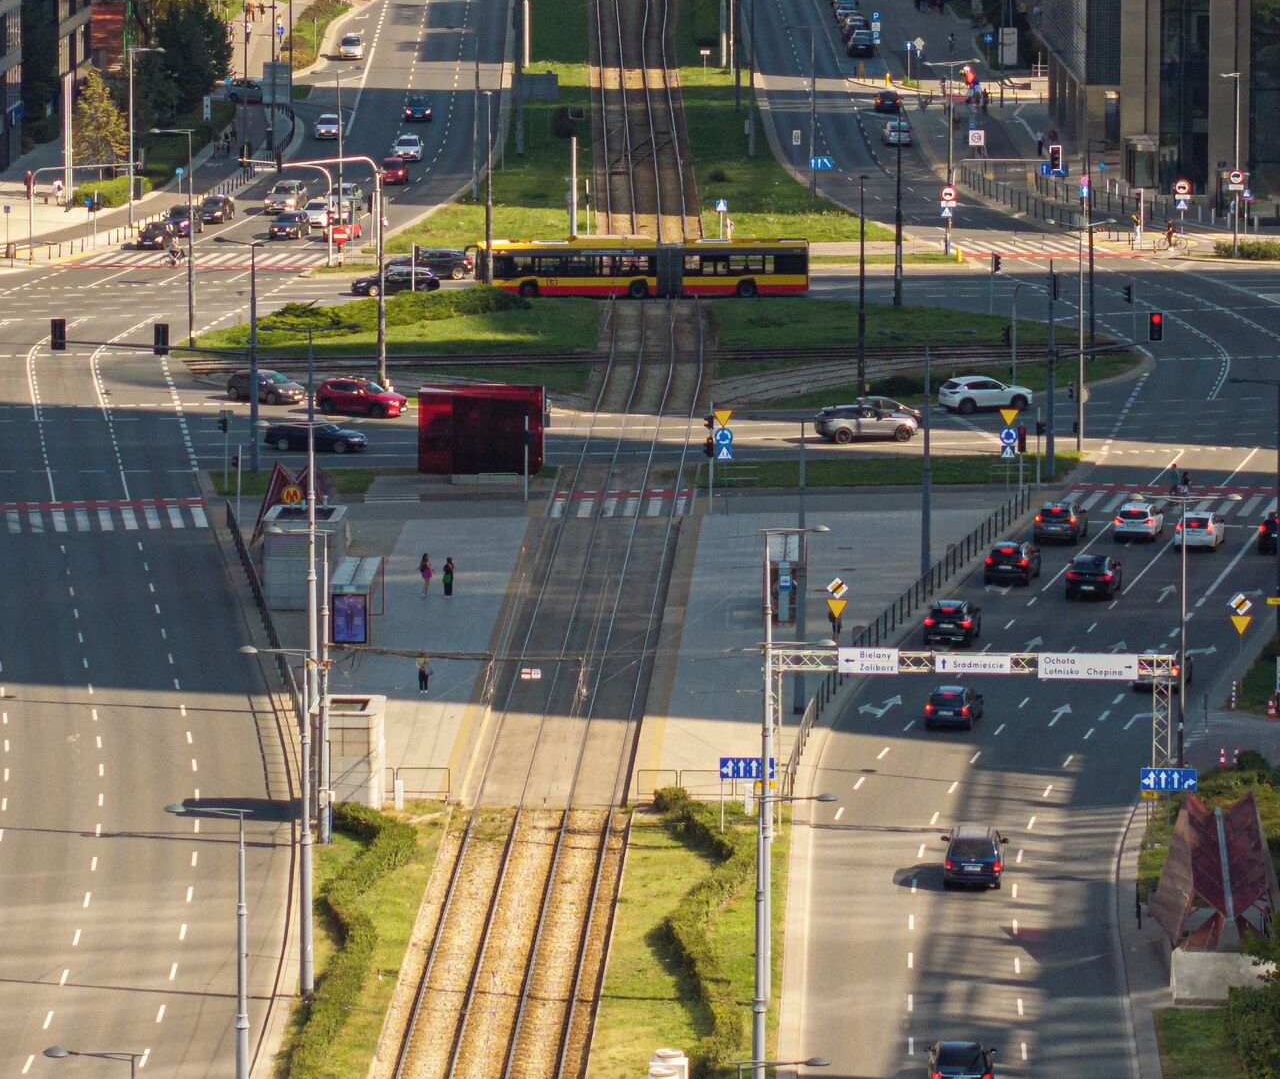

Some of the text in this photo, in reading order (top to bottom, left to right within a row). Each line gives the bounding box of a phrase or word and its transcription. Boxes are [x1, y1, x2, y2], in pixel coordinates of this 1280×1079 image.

[859, 651, 891, 660] Bielany
[1044, 657, 1076, 665] Ochota
[1044, 667, 1123, 677] Lotnisko Chopina
